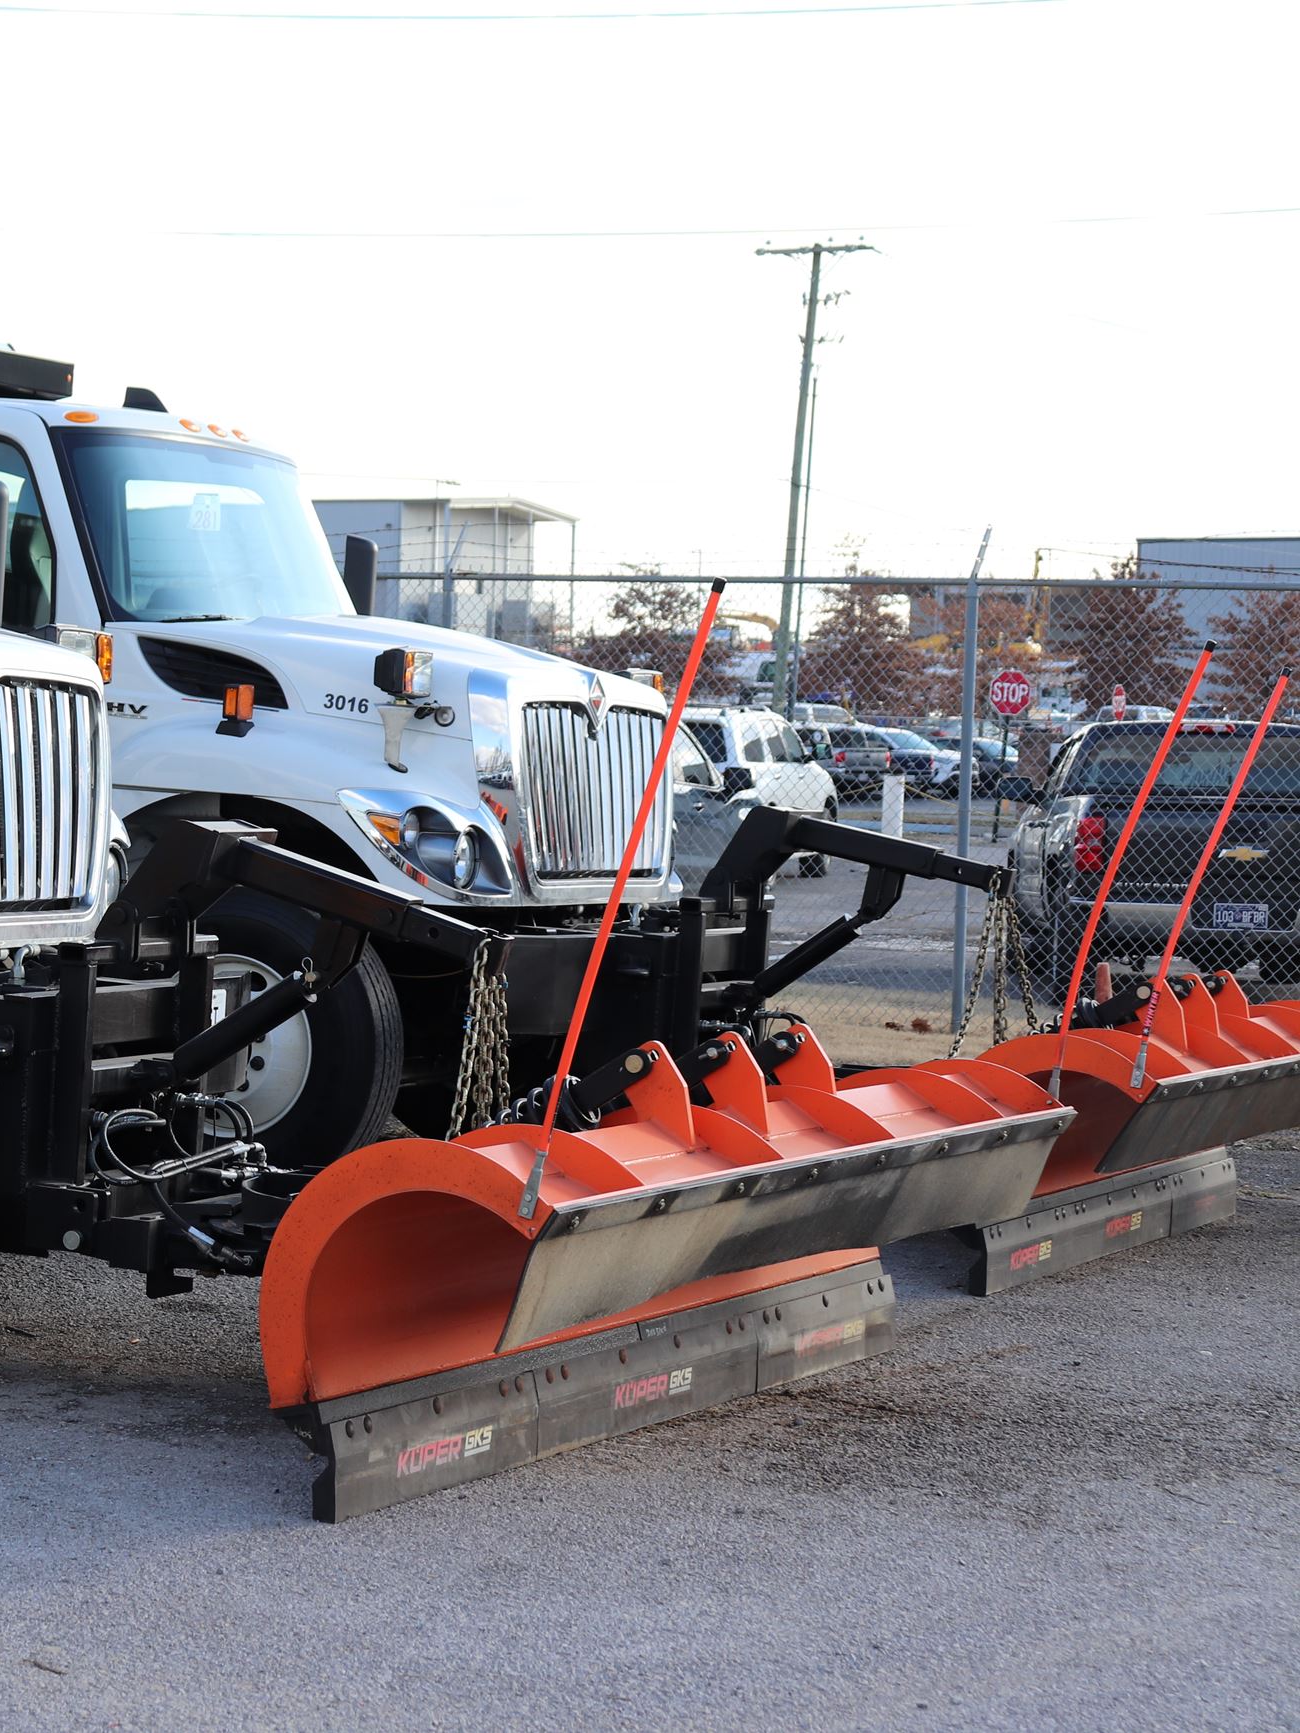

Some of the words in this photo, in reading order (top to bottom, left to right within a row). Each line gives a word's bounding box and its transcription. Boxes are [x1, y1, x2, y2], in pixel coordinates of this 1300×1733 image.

[192, 510, 217, 529] 281
[323, 693, 369, 714] 3016
[992, 681, 1029, 704] STOP
[107, 702, 148, 715] HV
[669, 1366, 693, 1389] GKS
[464, 1424, 494, 1451] GKS
